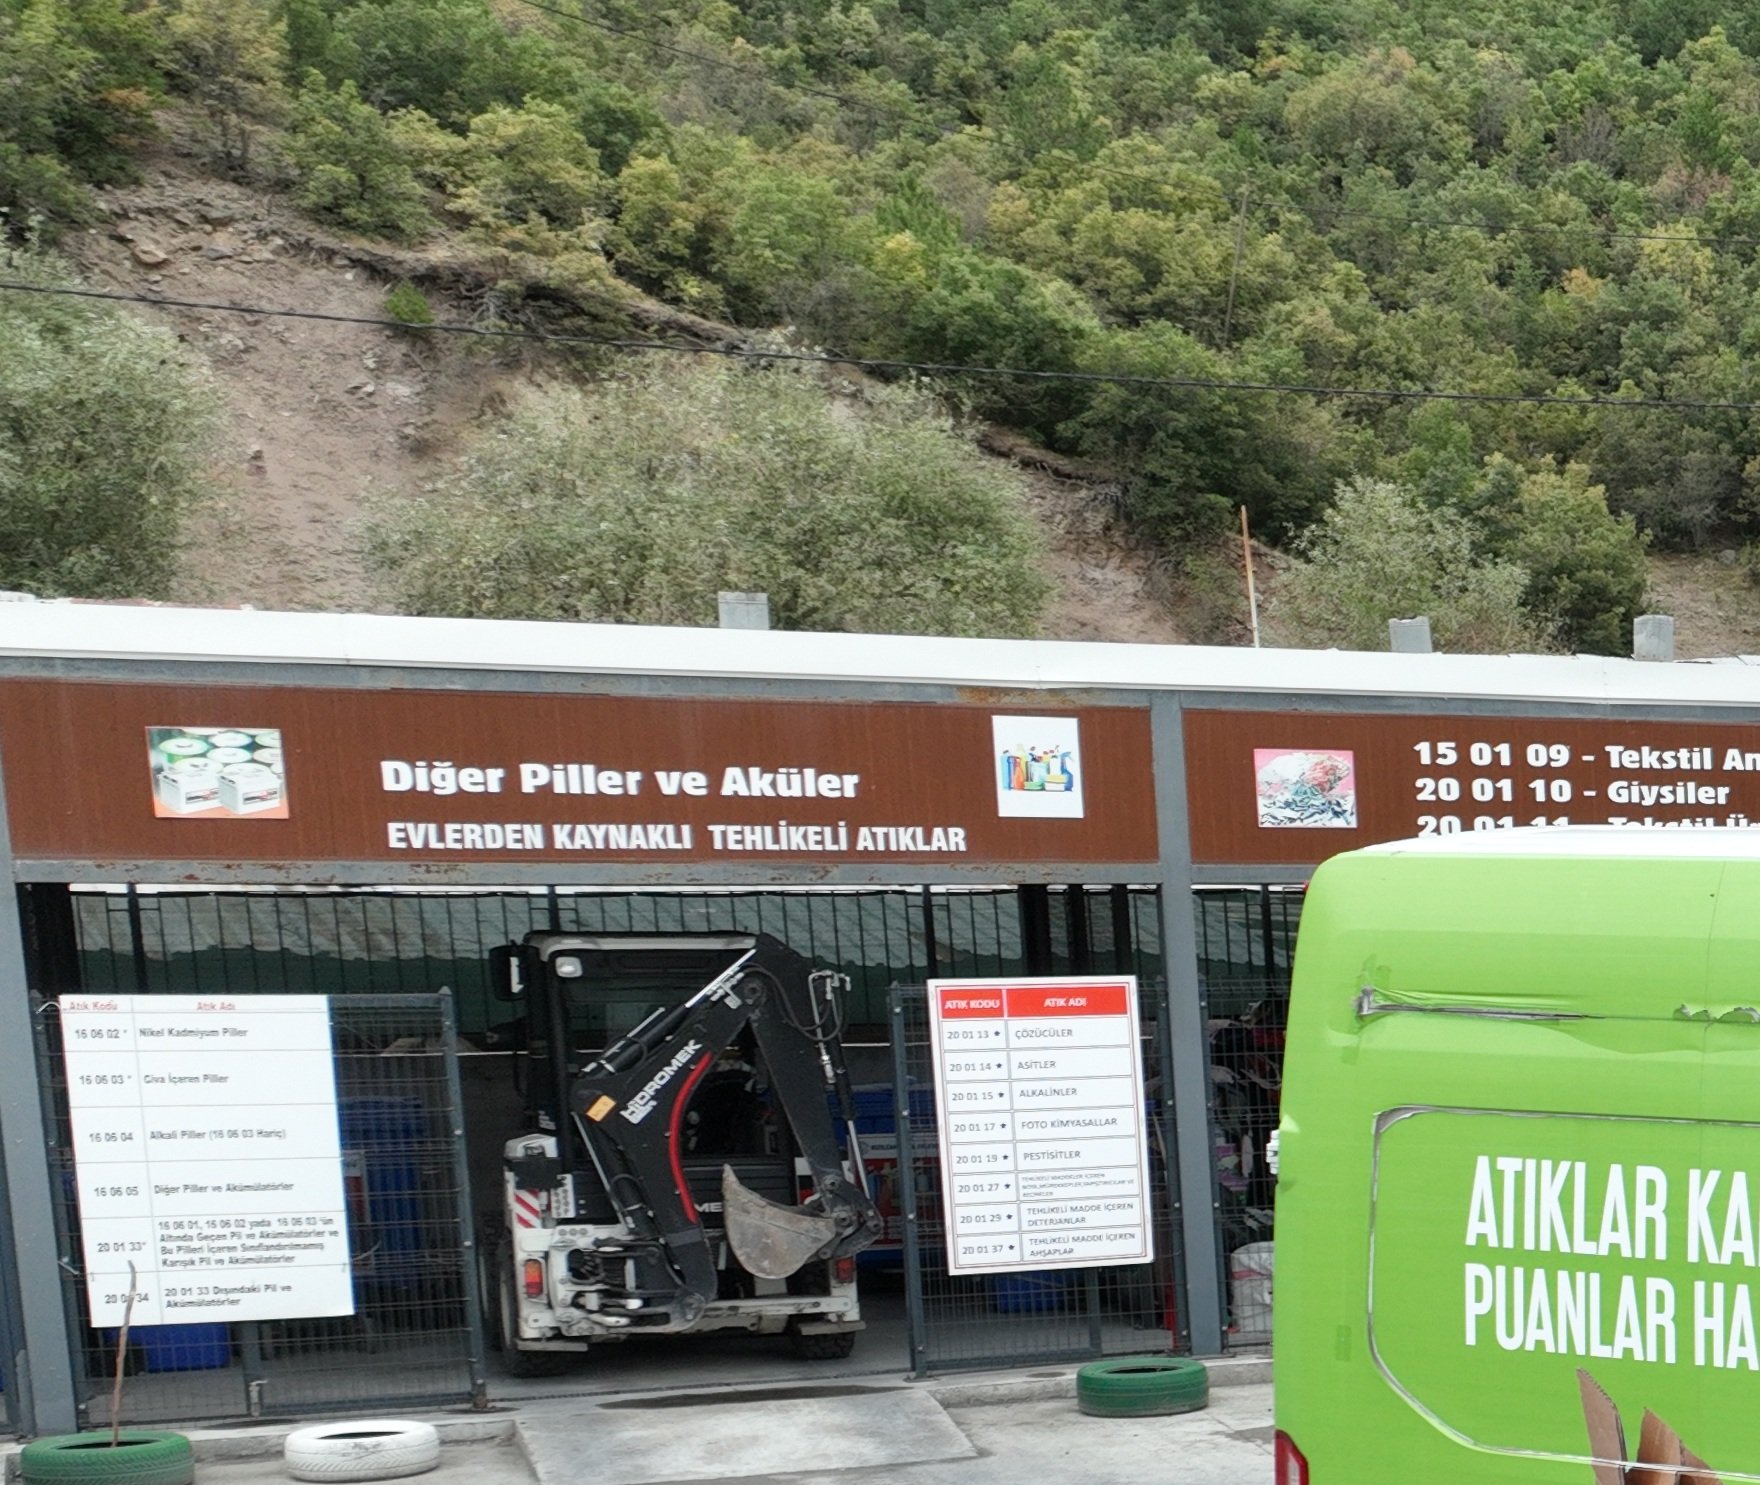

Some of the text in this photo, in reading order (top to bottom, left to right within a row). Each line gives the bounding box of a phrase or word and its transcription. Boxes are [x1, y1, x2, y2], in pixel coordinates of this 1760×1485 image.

[1413, 741, 1457, 765] 15
[1470, 742, 1510, 765] 01
[1526, 743, 1569, 767] 09
[1604, 745, 1711, 769] Tekstil
[380, 760, 858, 797] Diğer Piller ve Aküler
[1415, 777, 1459, 801] 20
[1471, 778, 1512, 801] 01
[1528, 779, 1571, 802] 10
[1607, 780, 1729, 806] Giysiler
[387, 820, 966, 851] EVLERDEN KAYNAKLI TEHLİKELİ ATIKLAR
[1417, 815, 1461, 838] 20
[1465, 1155, 1666, 1259] ATIKLAR
[1465, 1263, 1675, 1363] PUANLAR
